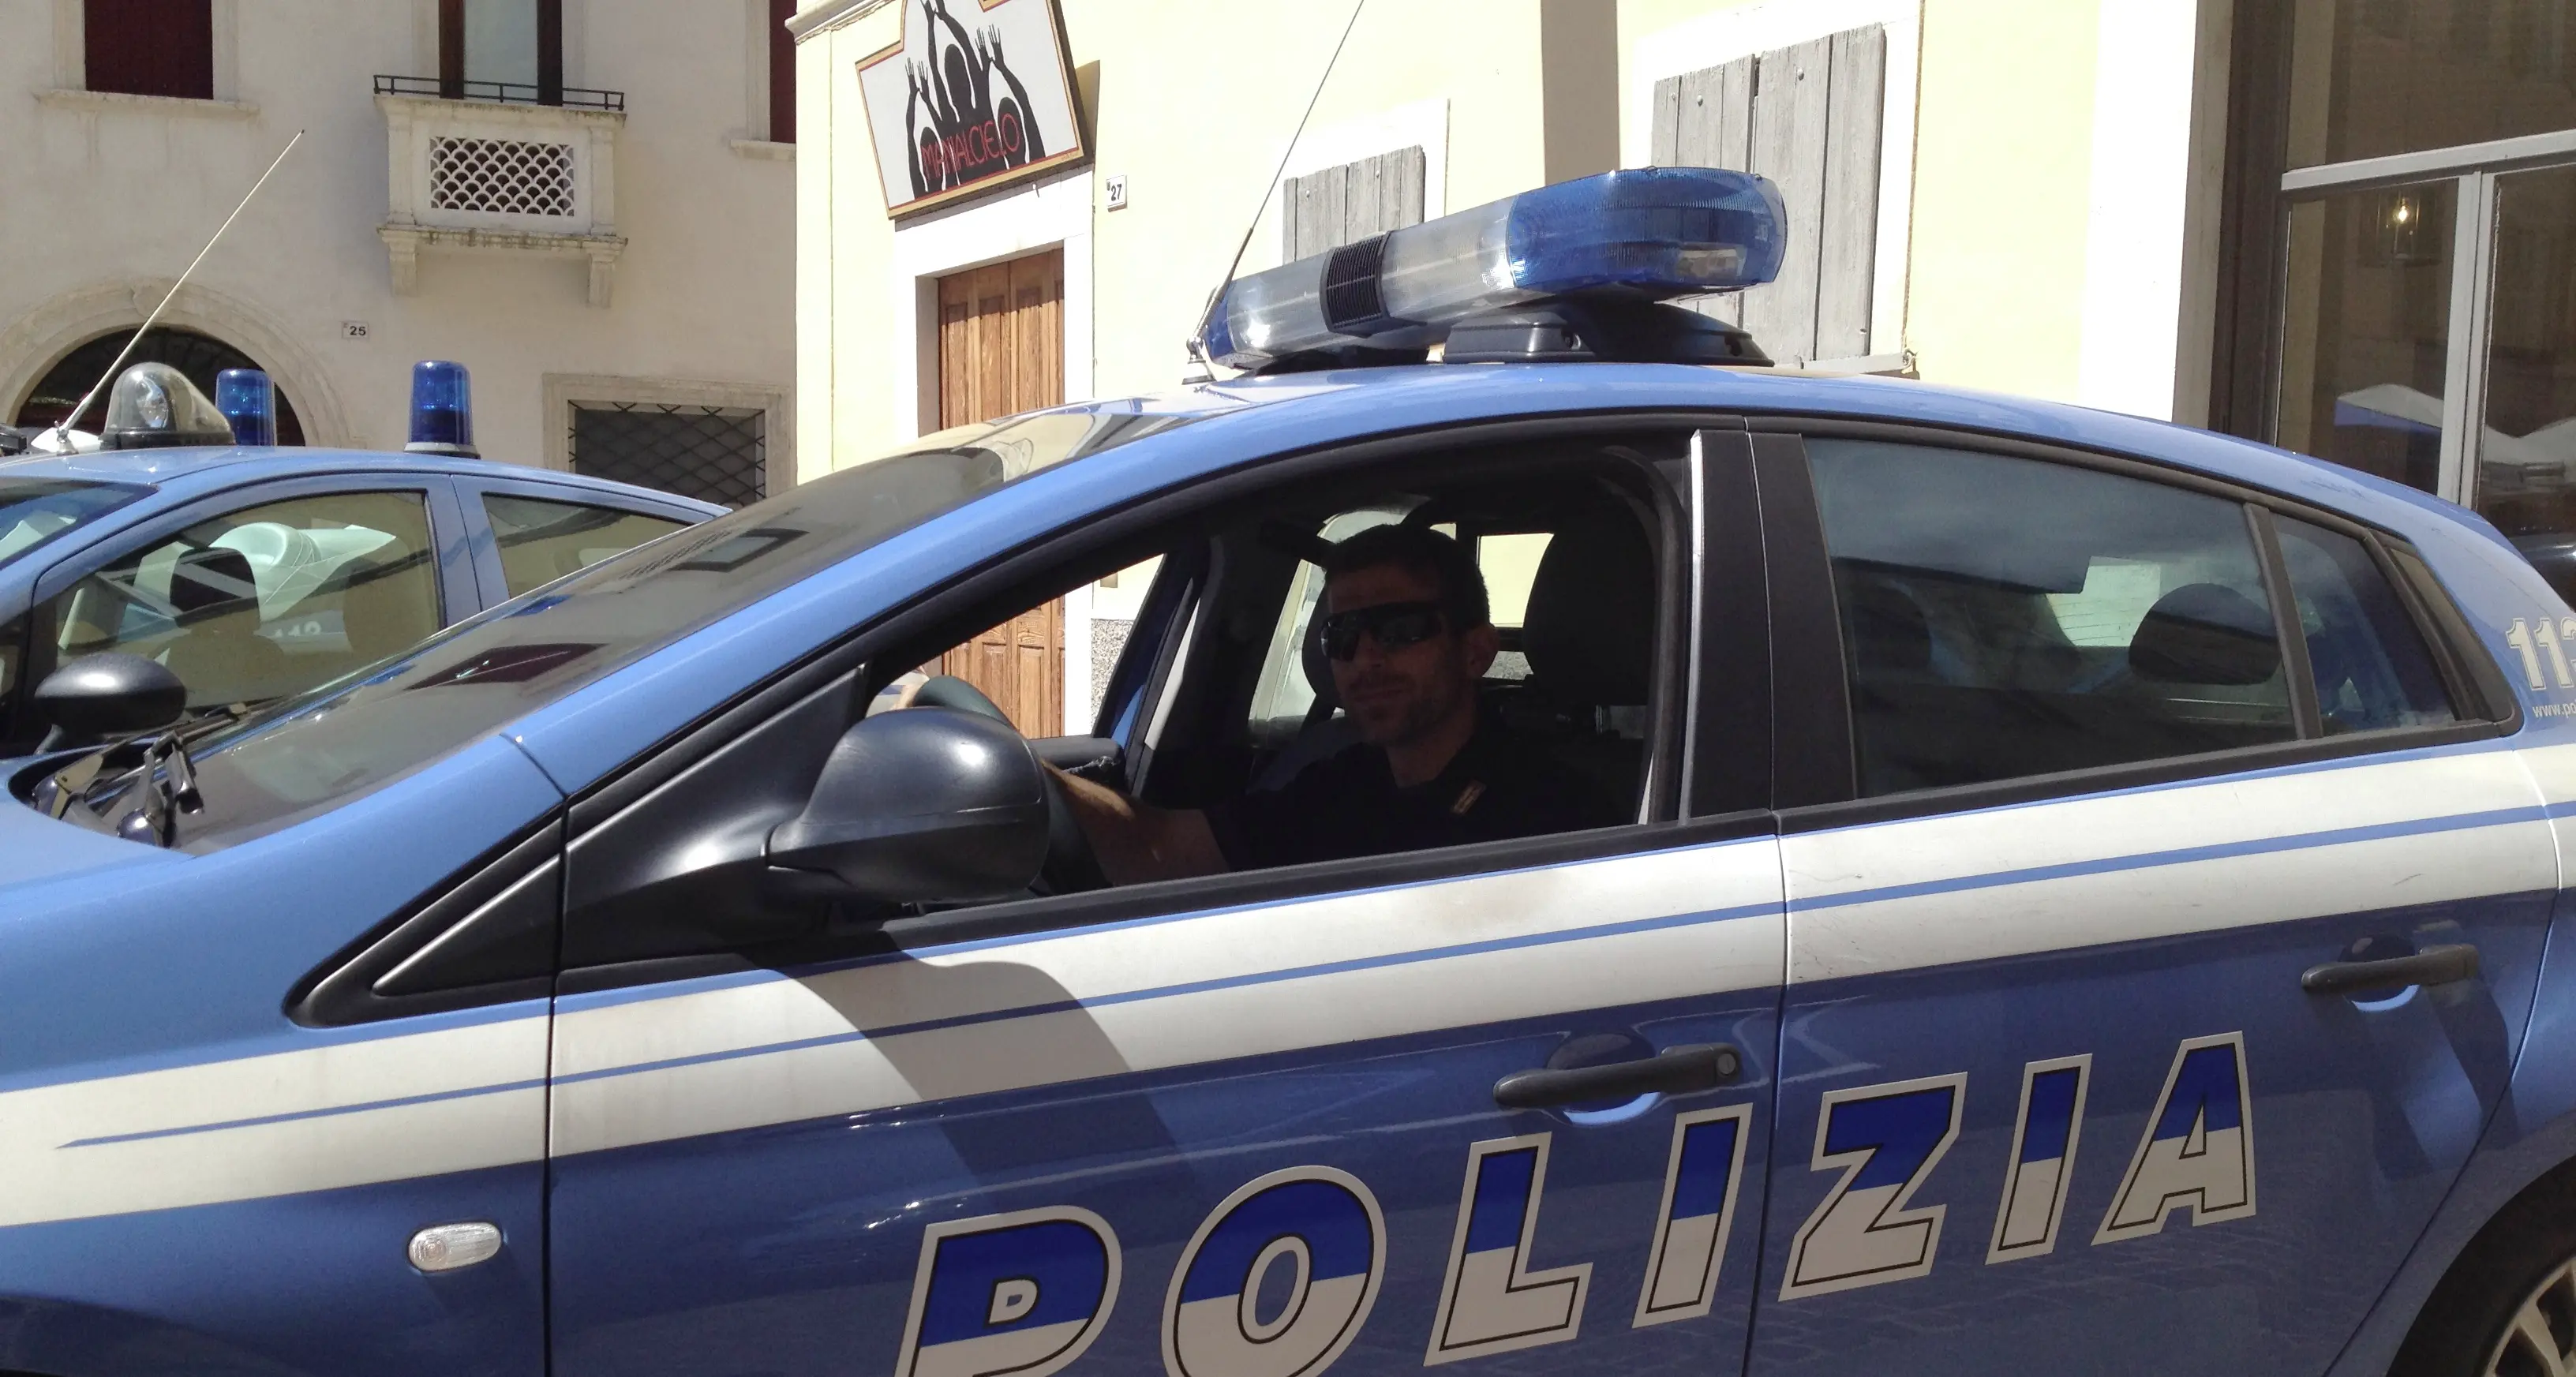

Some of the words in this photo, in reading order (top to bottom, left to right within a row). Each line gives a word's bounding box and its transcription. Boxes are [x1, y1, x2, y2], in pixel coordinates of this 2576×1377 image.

[1111, 183, 1122, 201] 27
[350, 325, 366, 336] 25
[2532, 700, 2576, 719] www.po
[894, 1031, 2256, 1377] POLIZIA
